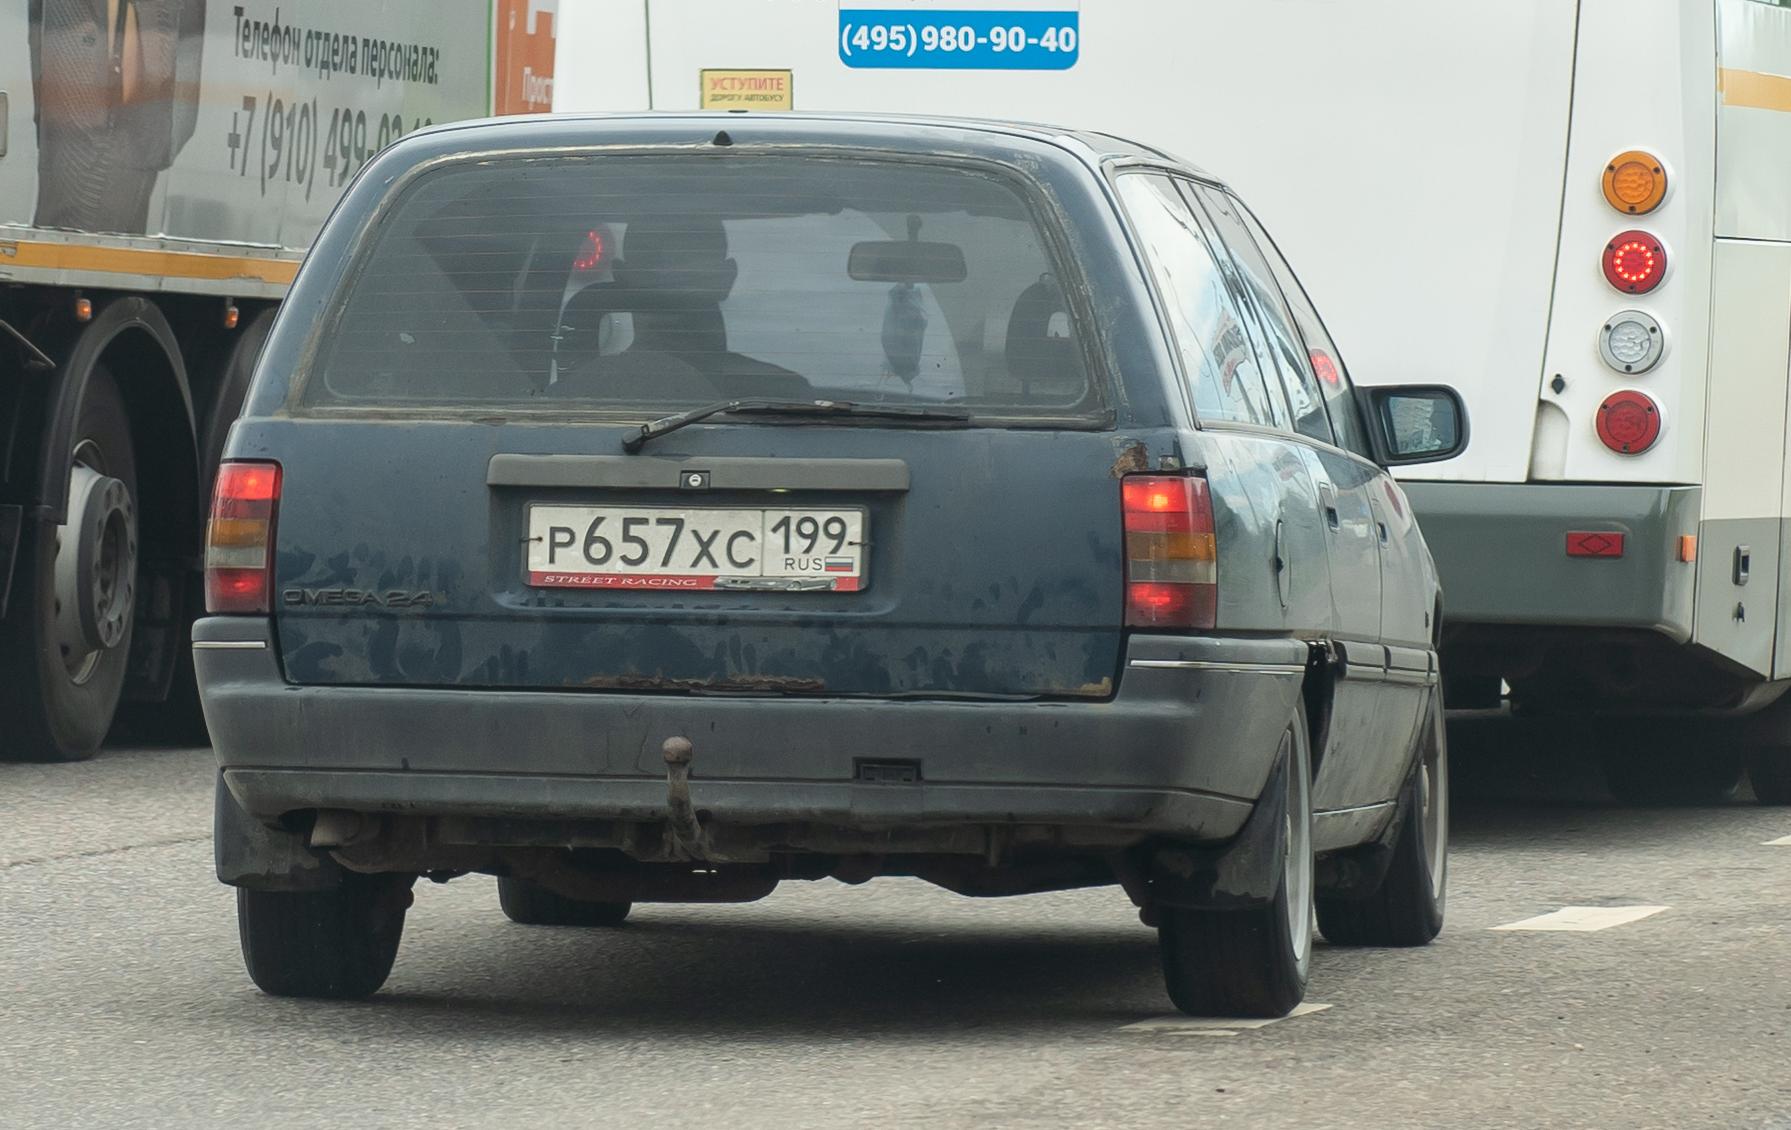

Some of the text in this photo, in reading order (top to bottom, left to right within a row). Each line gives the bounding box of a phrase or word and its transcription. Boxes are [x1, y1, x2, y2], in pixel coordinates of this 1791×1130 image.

[234, 6, 440, 90] Телефон отдела персонала:
[711, 77, 784, 91] УСТУПИТЕ
[227, 95, 257, 176] +7
[260, 90, 317, 203] (910)
[770, 516, 847, 554] 199
[784, 558, 823, 571] RUS
[544, 575, 697, 587] STREET RACING
[282, 588, 383, 606] OMEGA
